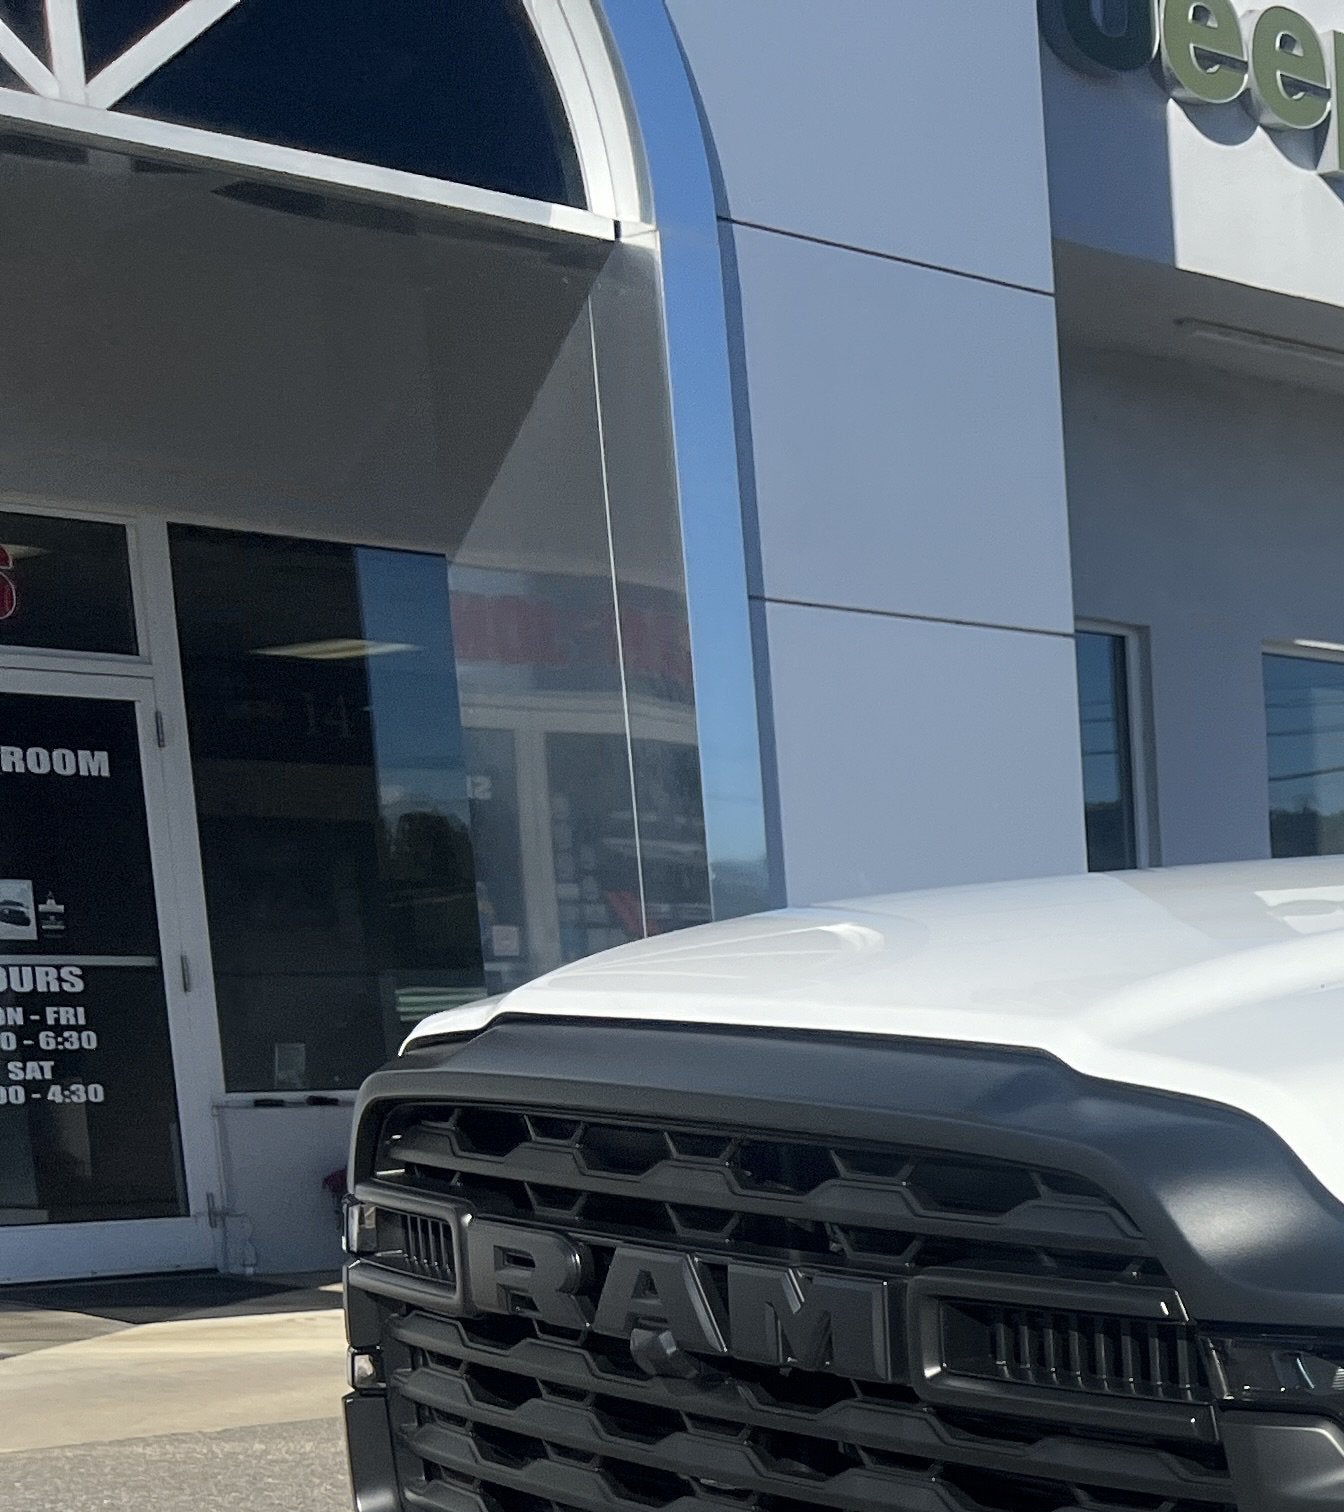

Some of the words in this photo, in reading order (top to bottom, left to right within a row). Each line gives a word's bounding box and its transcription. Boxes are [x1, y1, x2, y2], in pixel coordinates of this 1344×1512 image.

[0, 745, 111, 778] ROOM
[45, 1006, 87, 1026] FRI
[38, 1030, 98, 1051] 6:30
[7, 1060, 55, 1081] SAT
[47, 1083, 105, 1104] 4:30
[468, 1215, 891, 1383] RAM
